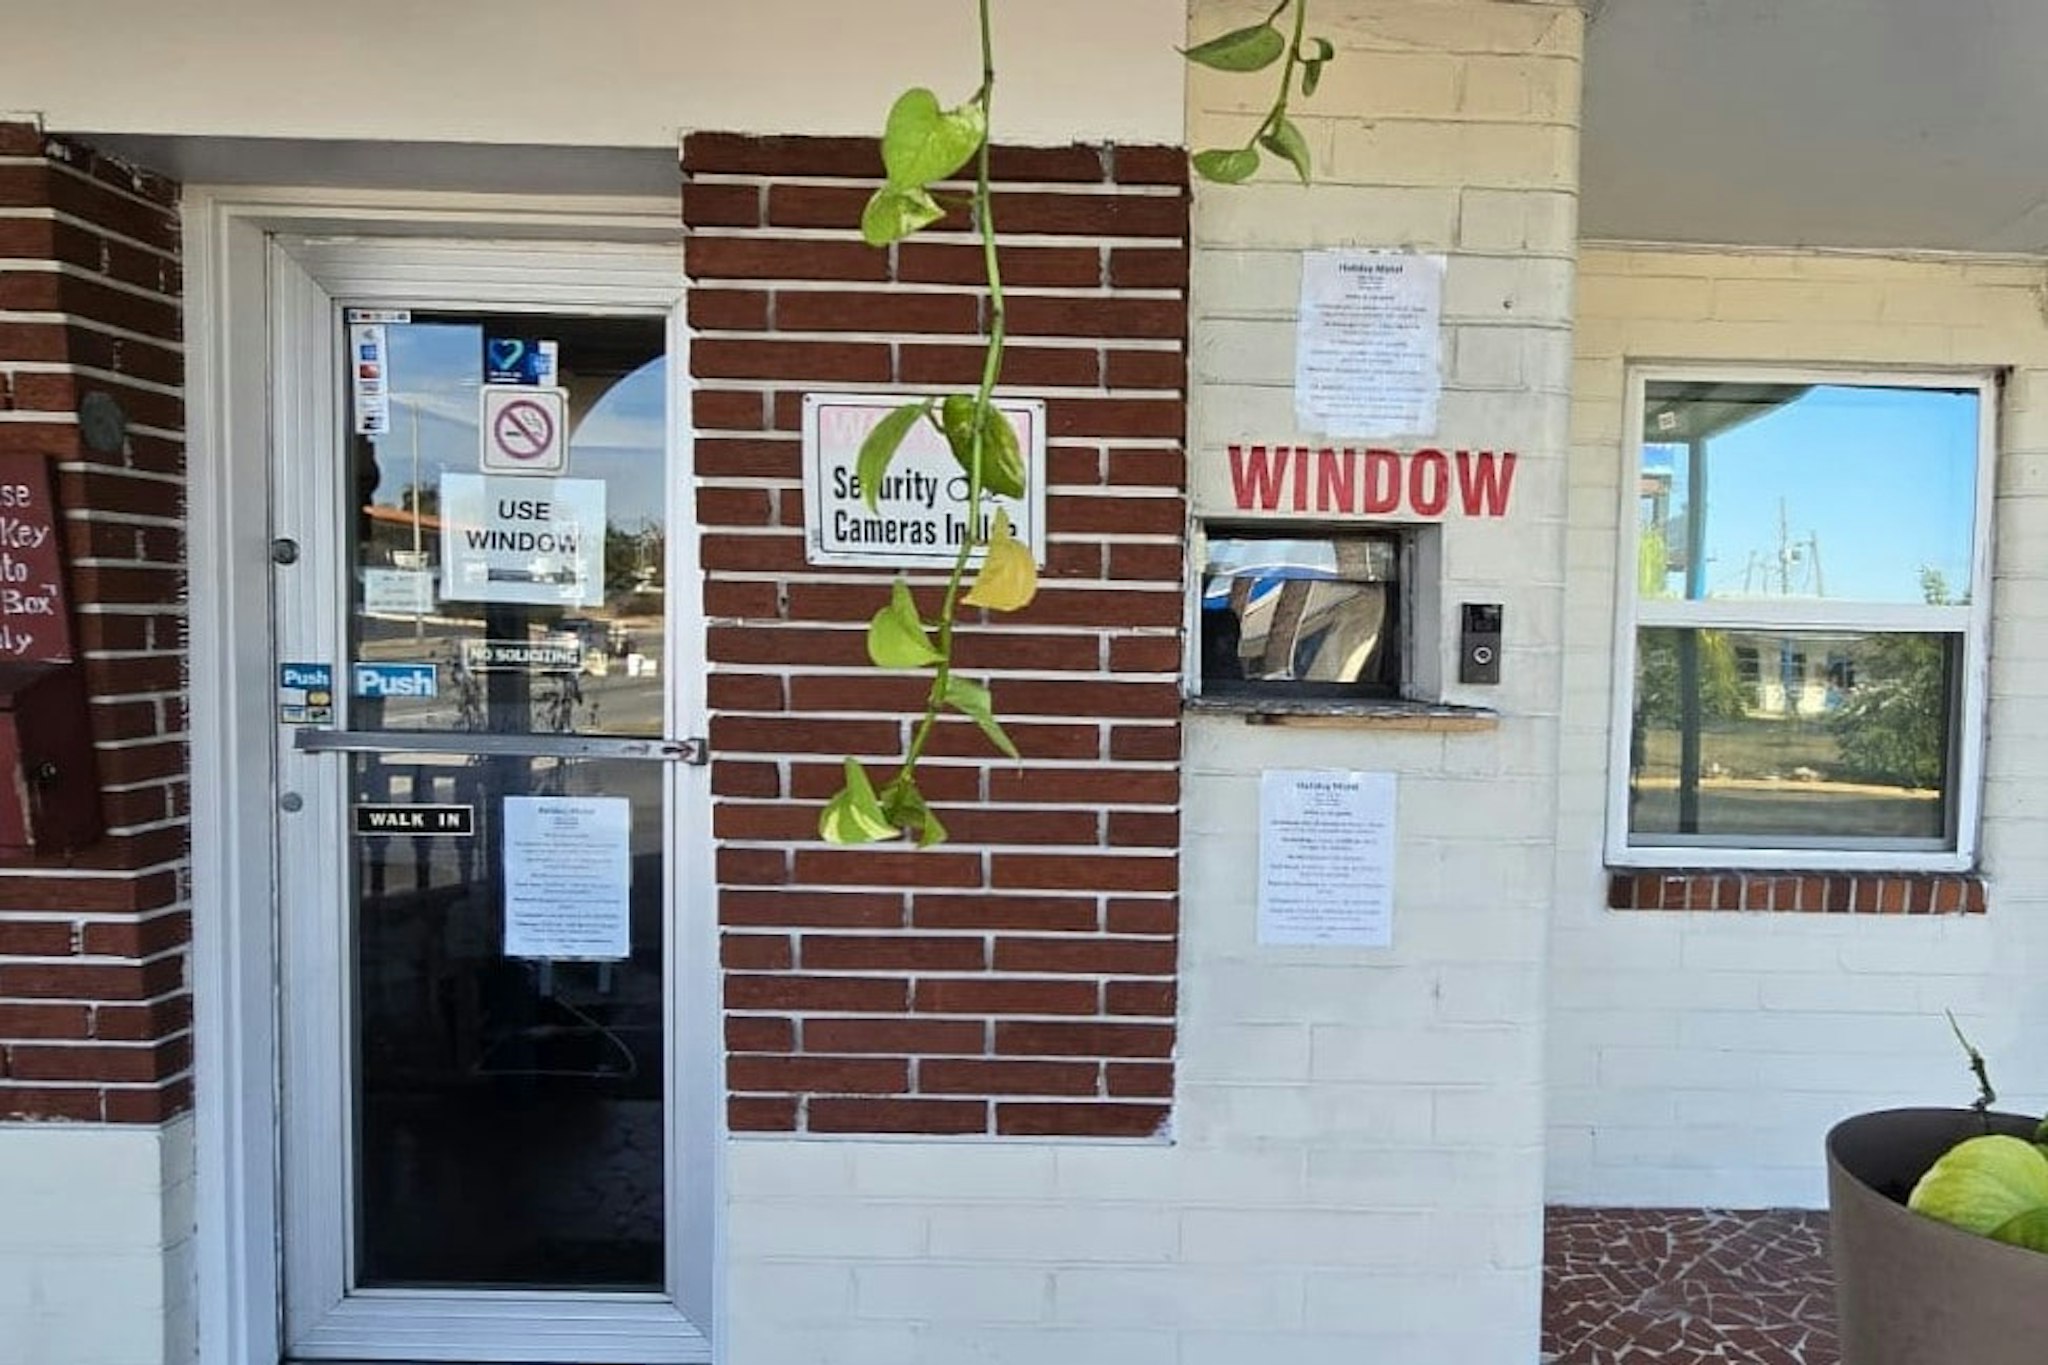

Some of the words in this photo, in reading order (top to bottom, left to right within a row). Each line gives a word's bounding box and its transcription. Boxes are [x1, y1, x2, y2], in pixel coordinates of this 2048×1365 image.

[834, 465, 938, 509] Seurity
[1229, 445, 1517, 517] WINDOW
[499, 500, 551, 520] USE
[0, 517, 50, 549] Key
[835, 510, 936, 544] Cameras
[946, 514, 967, 545] In
[465, 530, 578, 553] WINDOW
[0, 553, 28, 582] to
[469, 648, 493, 660] NO
[496, 649, 578, 663] SOLICITING
[284, 670, 328, 685] Push
[357, 670, 432, 696] Push
[369, 813, 424, 827] WALK
[438, 813, 461, 827] IN
